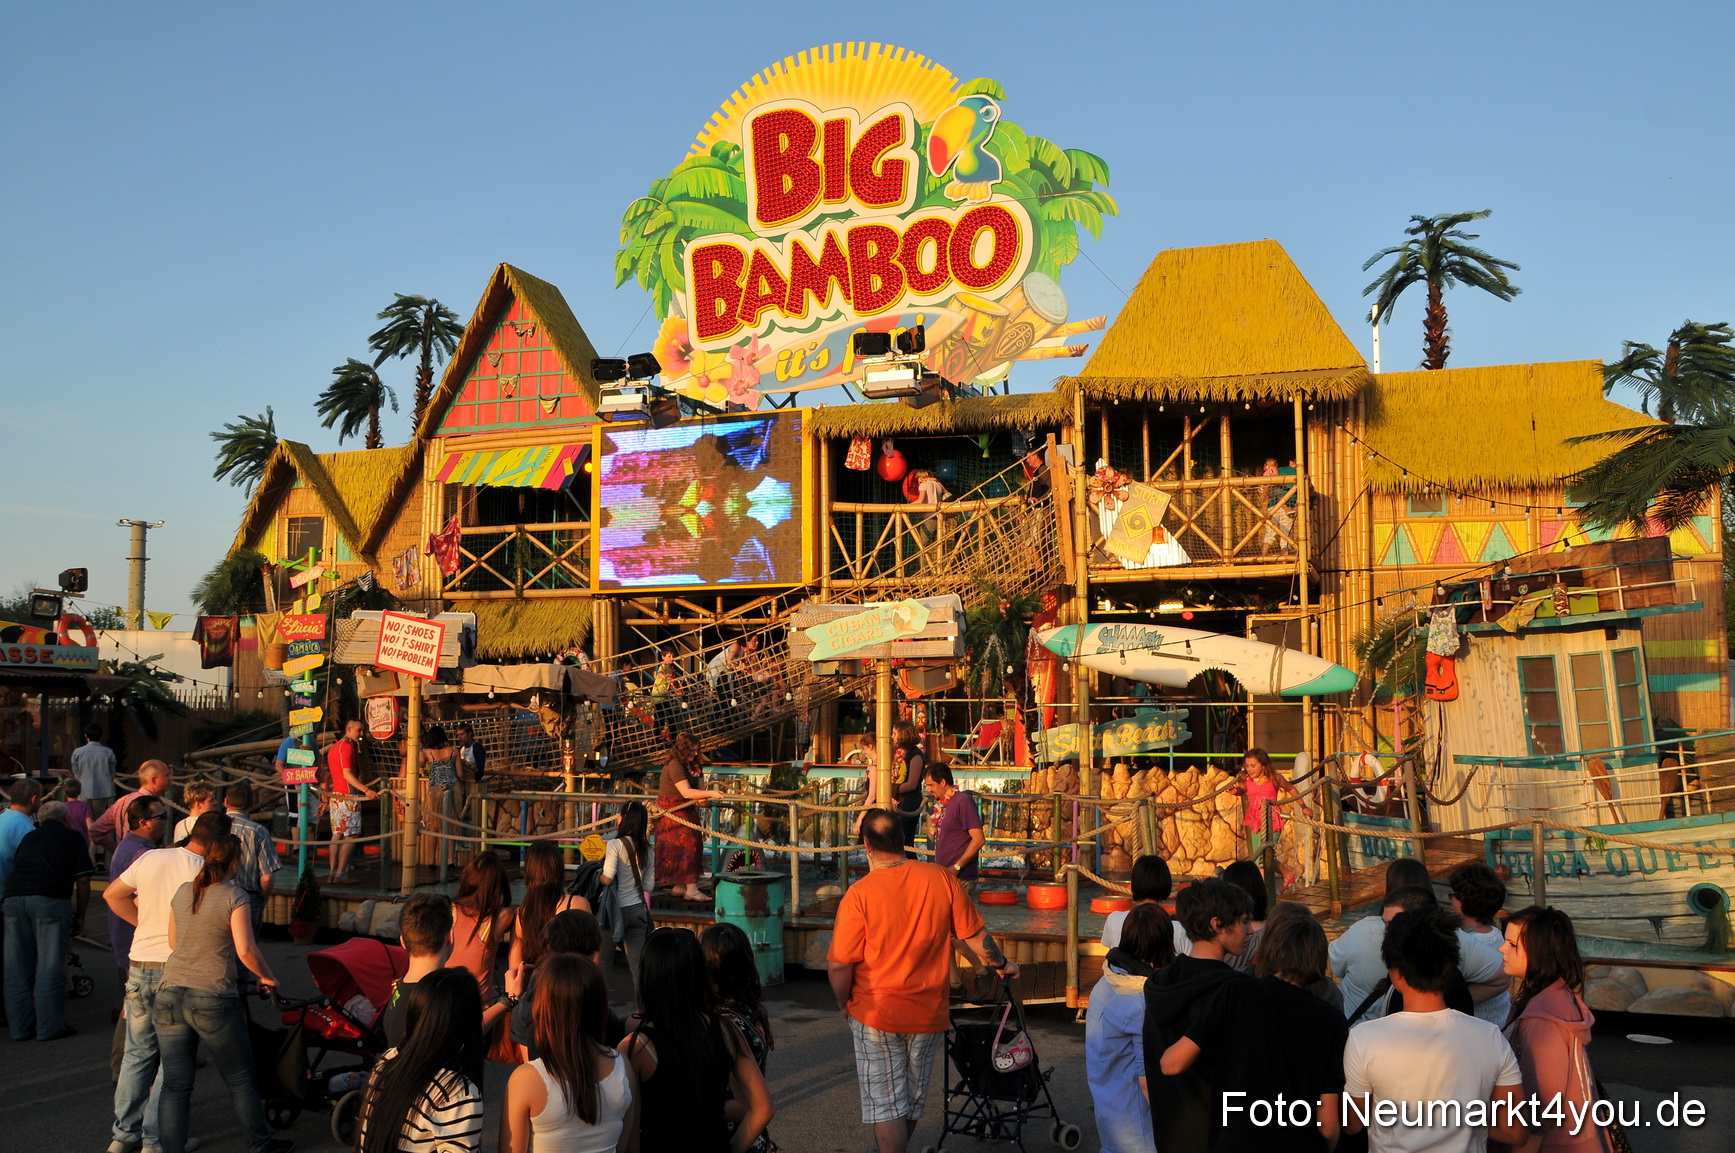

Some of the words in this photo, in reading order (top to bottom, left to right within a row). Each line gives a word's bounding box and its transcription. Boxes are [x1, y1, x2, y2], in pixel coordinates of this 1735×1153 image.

[751, 107, 909, 229] BIG
[691, 203, 1022, 343] BAMBOO
[775, 341, 830, 382] it's
[1132, 485, 1167, 508] STORM
[1106, 537, 1147, 561] WARNING
[386, 620, 405, 635] NO!
[404, 624, 436, 640] SHOES
[828, 612, 882, 638] CUBAN
[289, 641, 320, 655] JAMAICA
[383, 633, 400, 647] NO!
[830, 625, 884, 650] CIGARS
[381, 645, 397, 660] NO!
[396, 649, 434, 668] PROBLEM
[1051, 729, 1116, 757] Soth
[1115, 719, 1177, 747] Beach
[295, 769, 315, 781] BARTH
[1360, 834, 1415, 861] BORA
